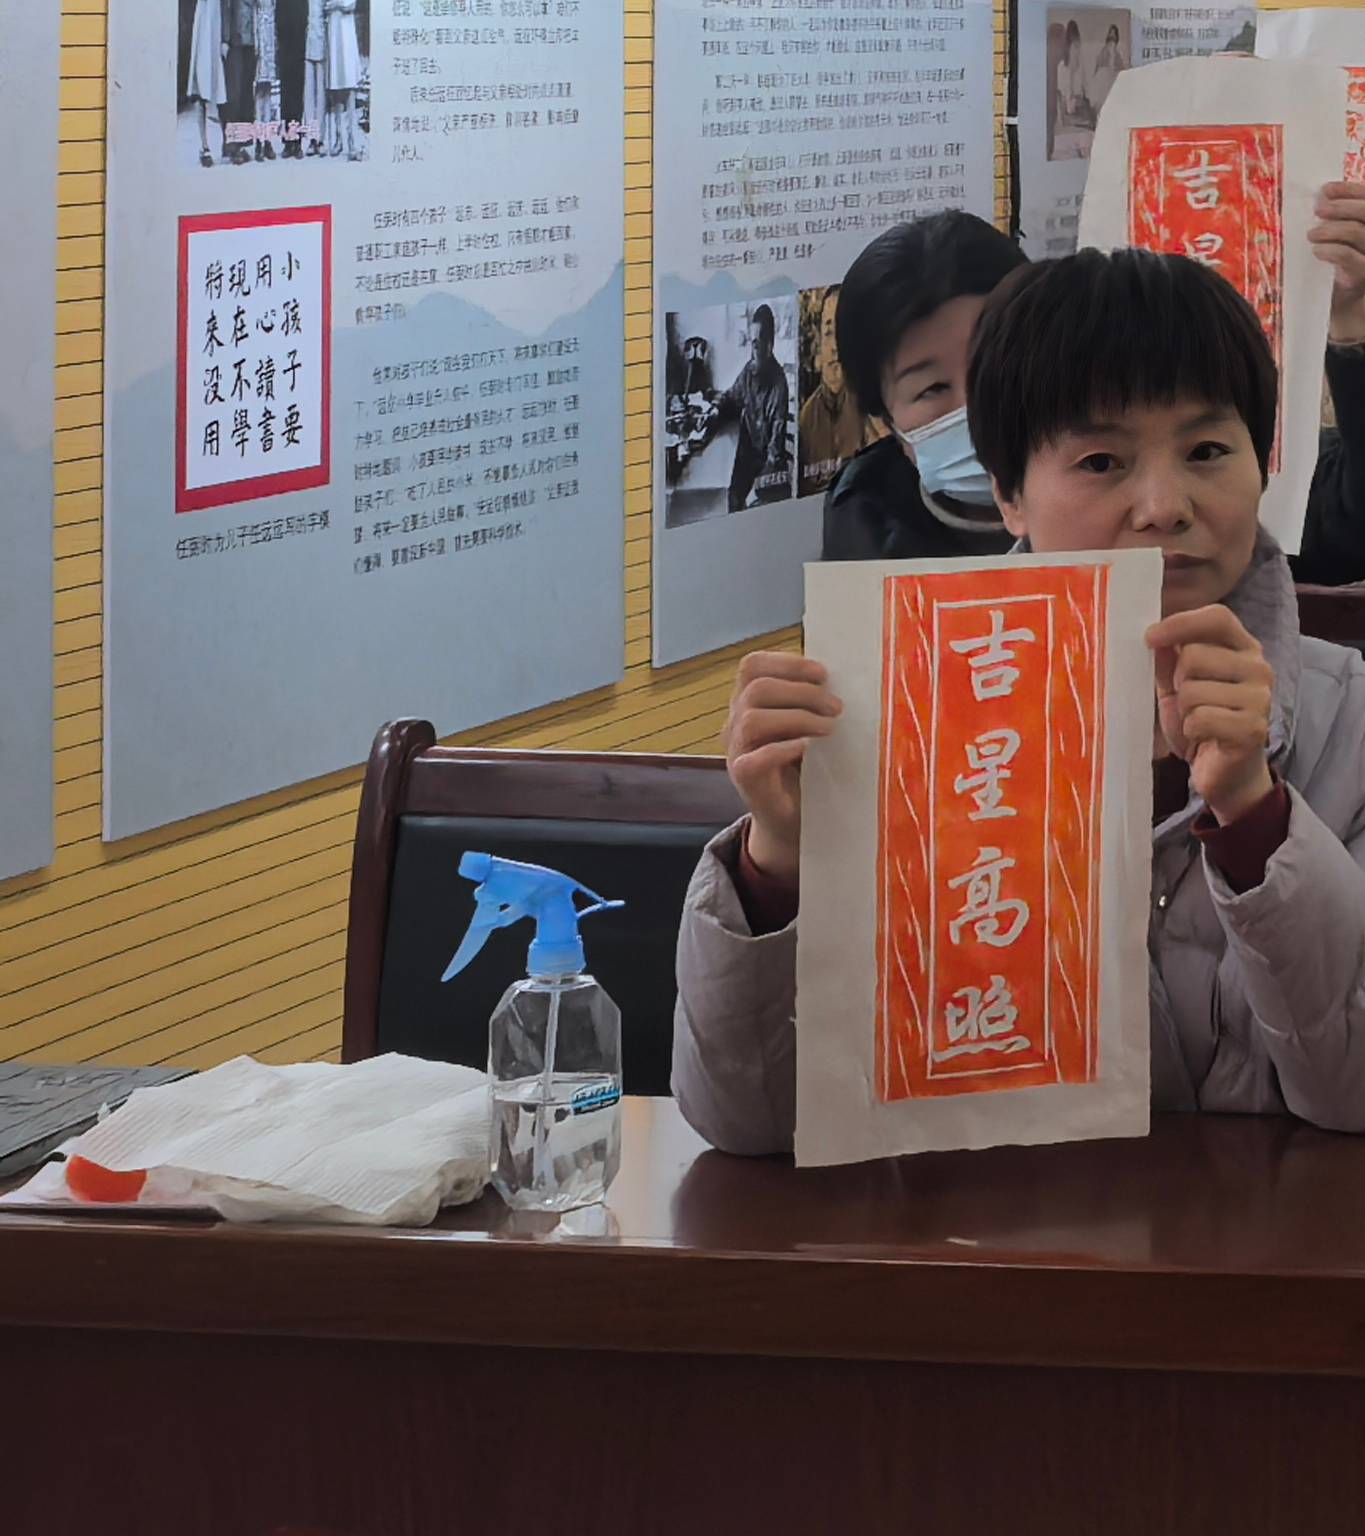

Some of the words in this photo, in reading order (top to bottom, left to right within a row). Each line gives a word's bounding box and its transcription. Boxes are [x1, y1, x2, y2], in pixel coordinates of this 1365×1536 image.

[280, 250, 304, 449] 小孩子要
[931, 609, 1035, 1063] 吉星高照
